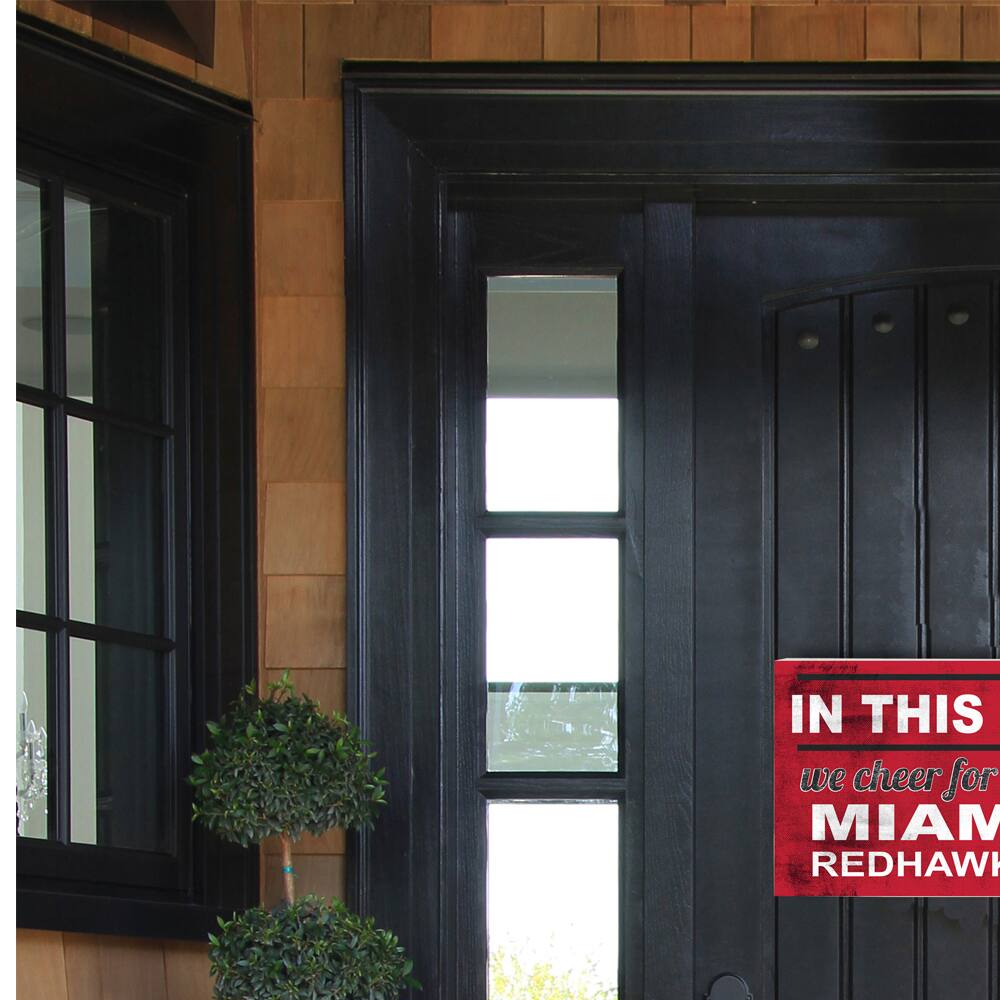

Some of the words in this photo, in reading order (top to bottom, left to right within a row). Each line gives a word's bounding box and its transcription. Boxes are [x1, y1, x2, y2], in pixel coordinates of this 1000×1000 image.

[791, 694, 842, 734] IN
[861, 693, 984, 735] THIS
[800, 768, 845, 792] we
[853, 760, 943, 792] cheer
[940, 757, 999, 802] for
